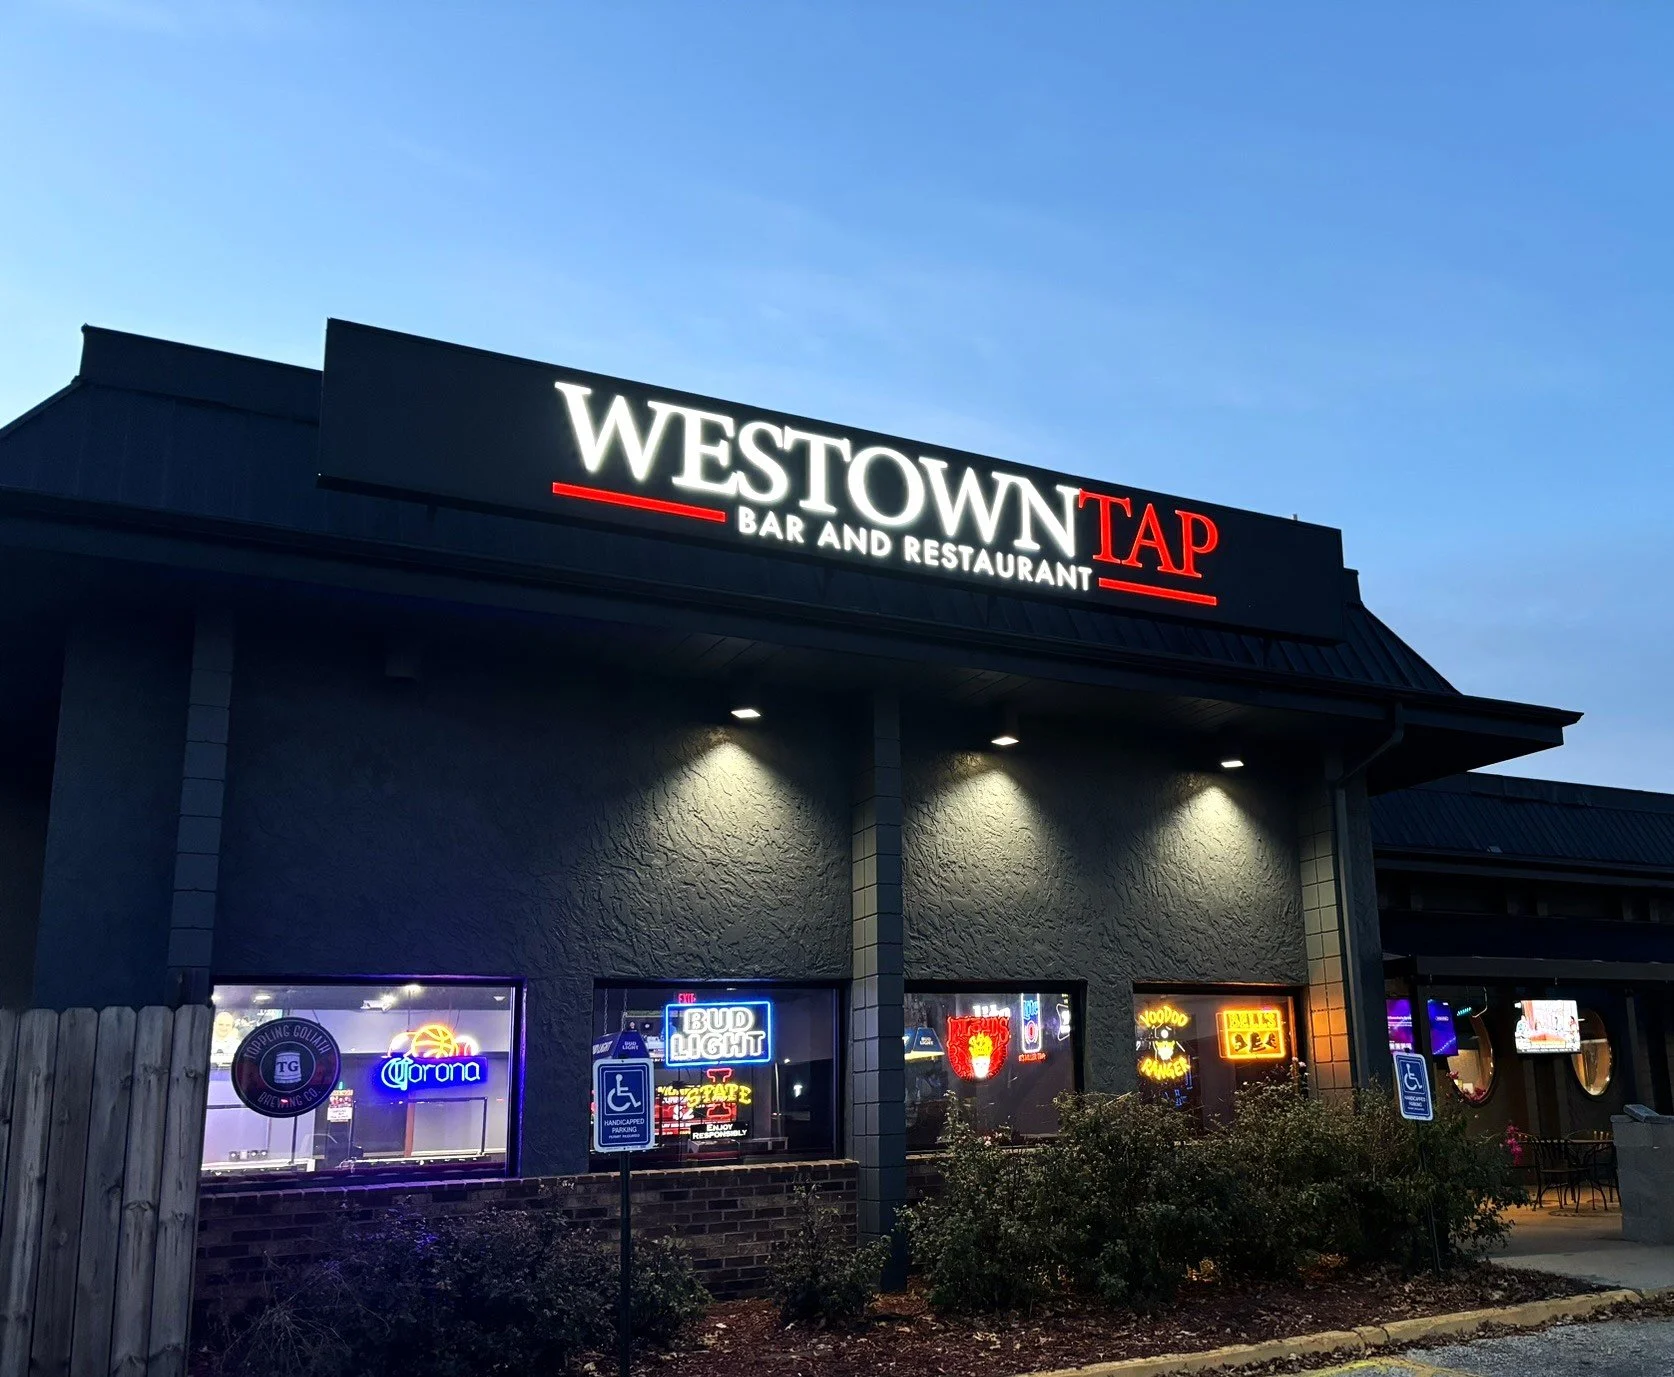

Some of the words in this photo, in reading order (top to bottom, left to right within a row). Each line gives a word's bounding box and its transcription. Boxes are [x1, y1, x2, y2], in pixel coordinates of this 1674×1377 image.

[553, 380, 1081, 559] WESTOWN
[1079, 488, 1219, 579] TAP
[737, 504, 805, 545] BAR
[817, 520, 892, 559] AND
[903, 535, 1093, 592] RESTAURANT
[684, 1007, 753, 1034] BUD
[1138, 1005, 1189, 1028] VOODOO
[243, 1024, 290, 1060] TOPPLING
[293, 1024, 332, 1054] GOLIATH
[670, 1030, 766, 1060] LIGHT
[277, 1060, 299, 1073] TG
[381, 1056, 480, 1091] Corona
[1140, 1056, 1191, 1081] RANGER
[604, 1118, 645, 1126] HANDICAPPED
[611, 1126, 637, 1134] PARKING
[692, 1129, 748, 1140] RESPONSIBLY
[706, 1123, 734, 1132] ENJOY
